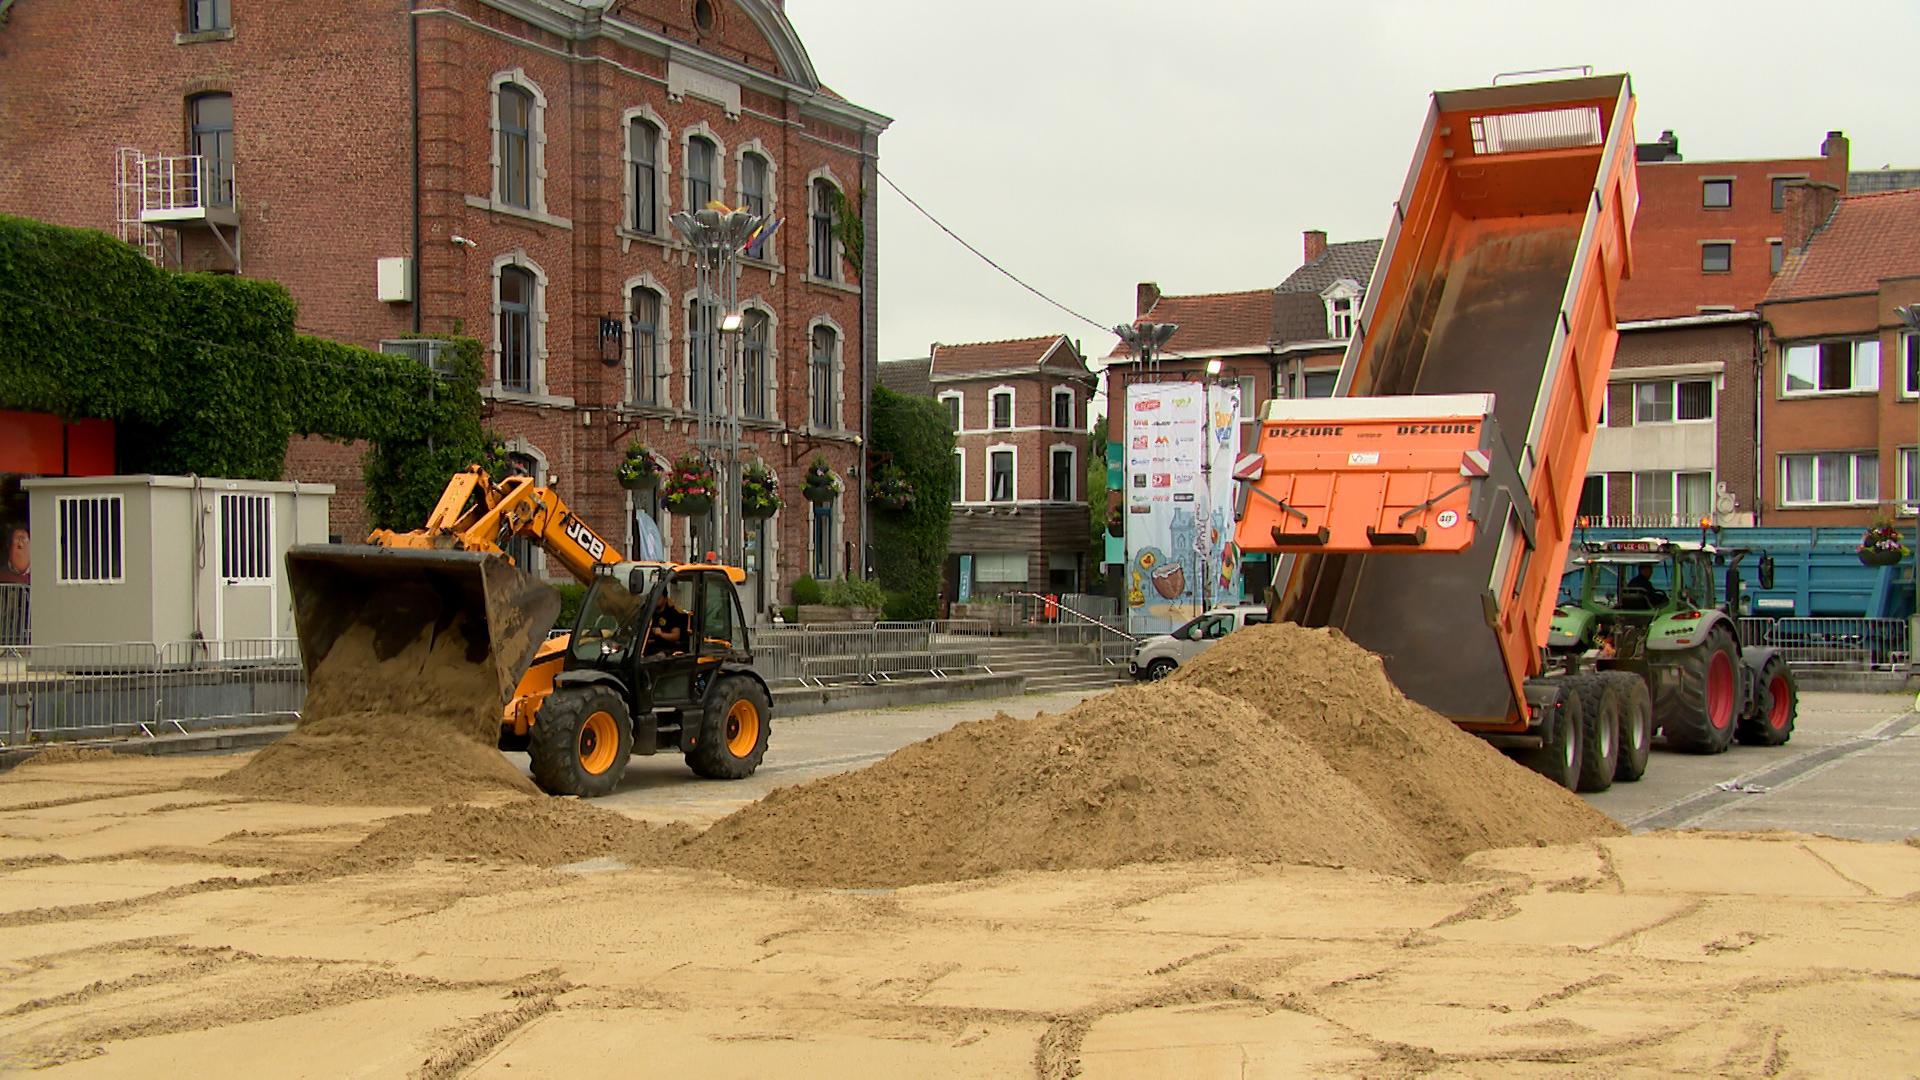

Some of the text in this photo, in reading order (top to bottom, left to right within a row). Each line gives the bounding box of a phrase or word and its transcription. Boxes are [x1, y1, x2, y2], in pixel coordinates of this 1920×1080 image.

[1268, 426, 1344, 438] DEZEURE
[1396, 424, 1476, 436] DEZEURE
[566, 522, 605, 561] JCB
